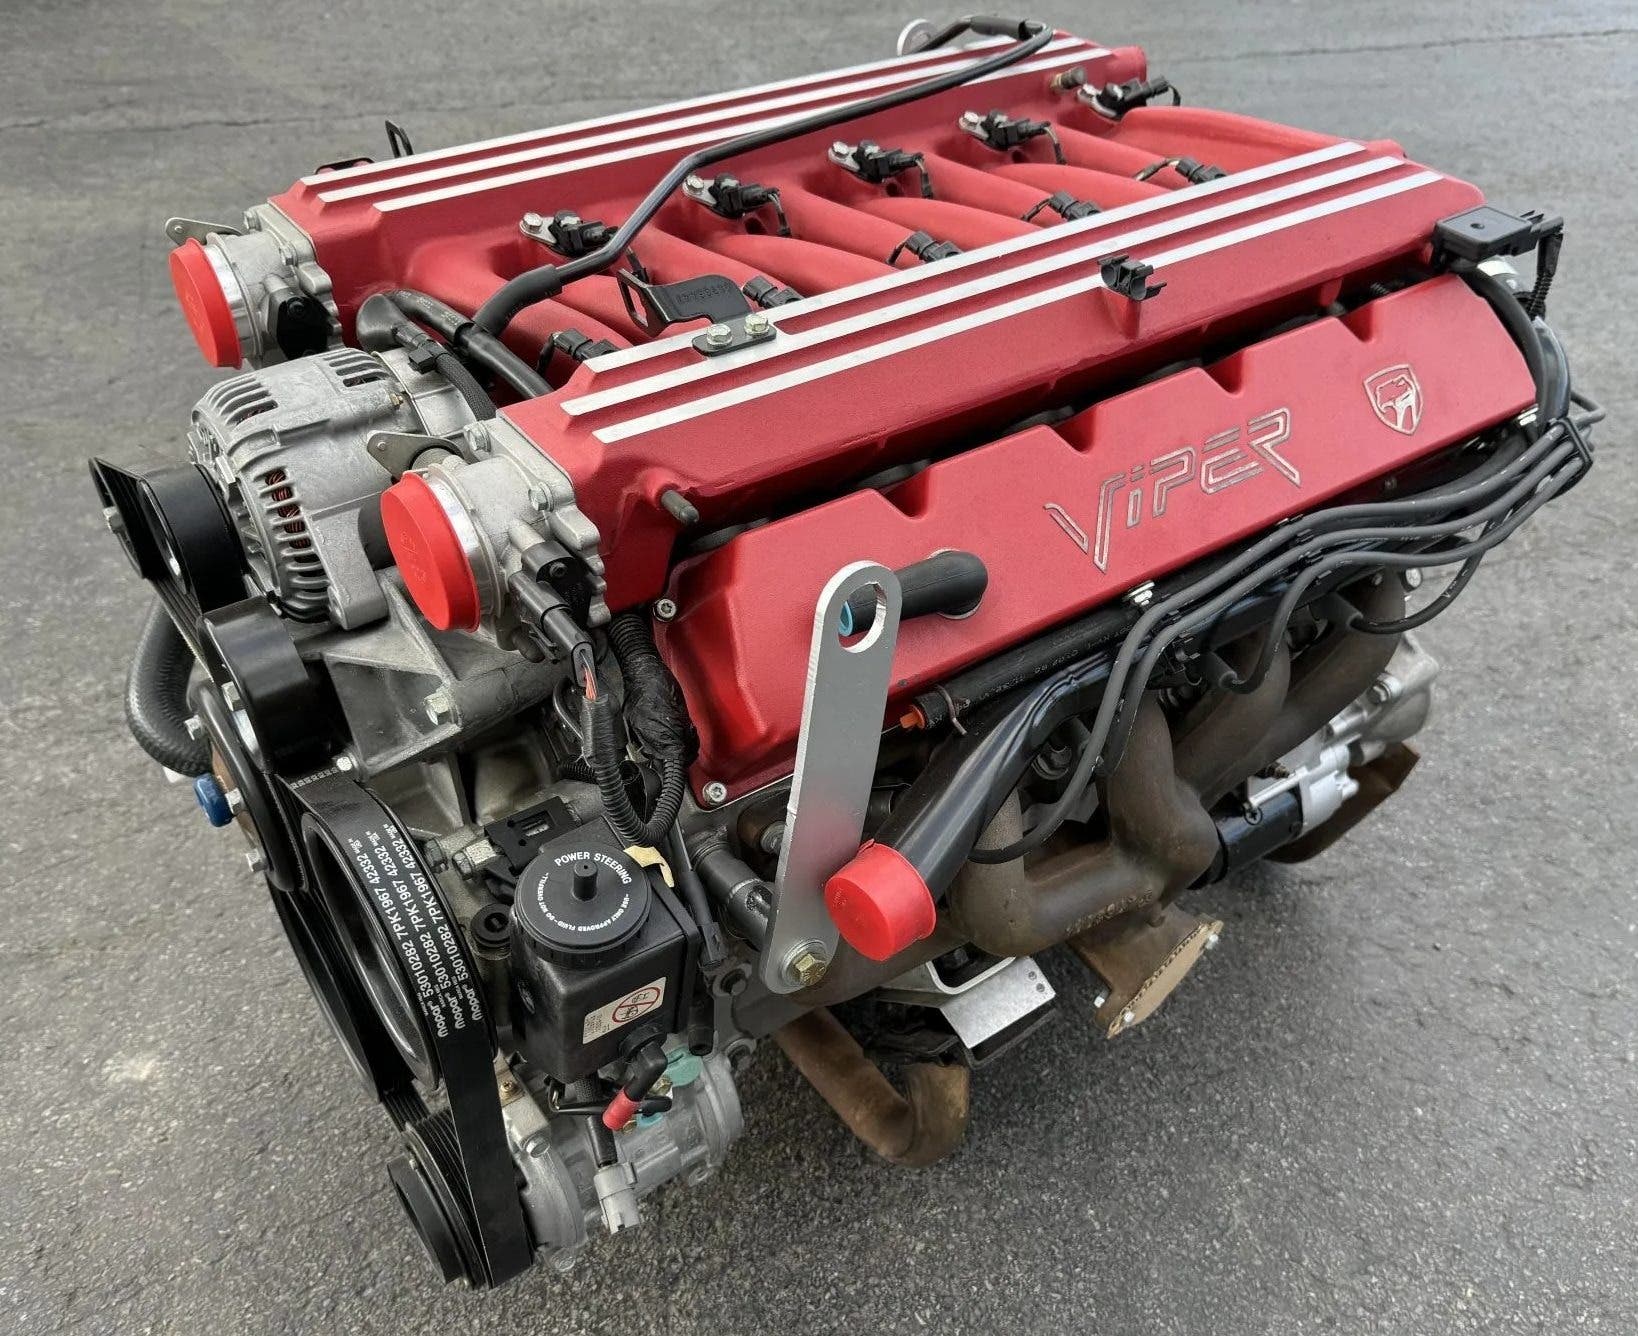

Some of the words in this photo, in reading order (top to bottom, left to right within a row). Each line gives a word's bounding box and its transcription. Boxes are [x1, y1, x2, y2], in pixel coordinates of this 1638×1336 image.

[356, 853, 380, 884] 42332
[374, 845, 398, 876] 42332
[392, 838, 416, 868] 42332
[554, 851, 590, 867] POWER
[593, 852, 632, 885] STEERING
[374, 888, 408, 940] 7PK1967
[392, 880, 426, 932] 7PK1967
[409, 872, 444, 924] 7PK1967
[401, 939, 434, 998] 53010282
[419, 931, 451, 989] 53010282
[437, 923, 468, 981] 53010282
